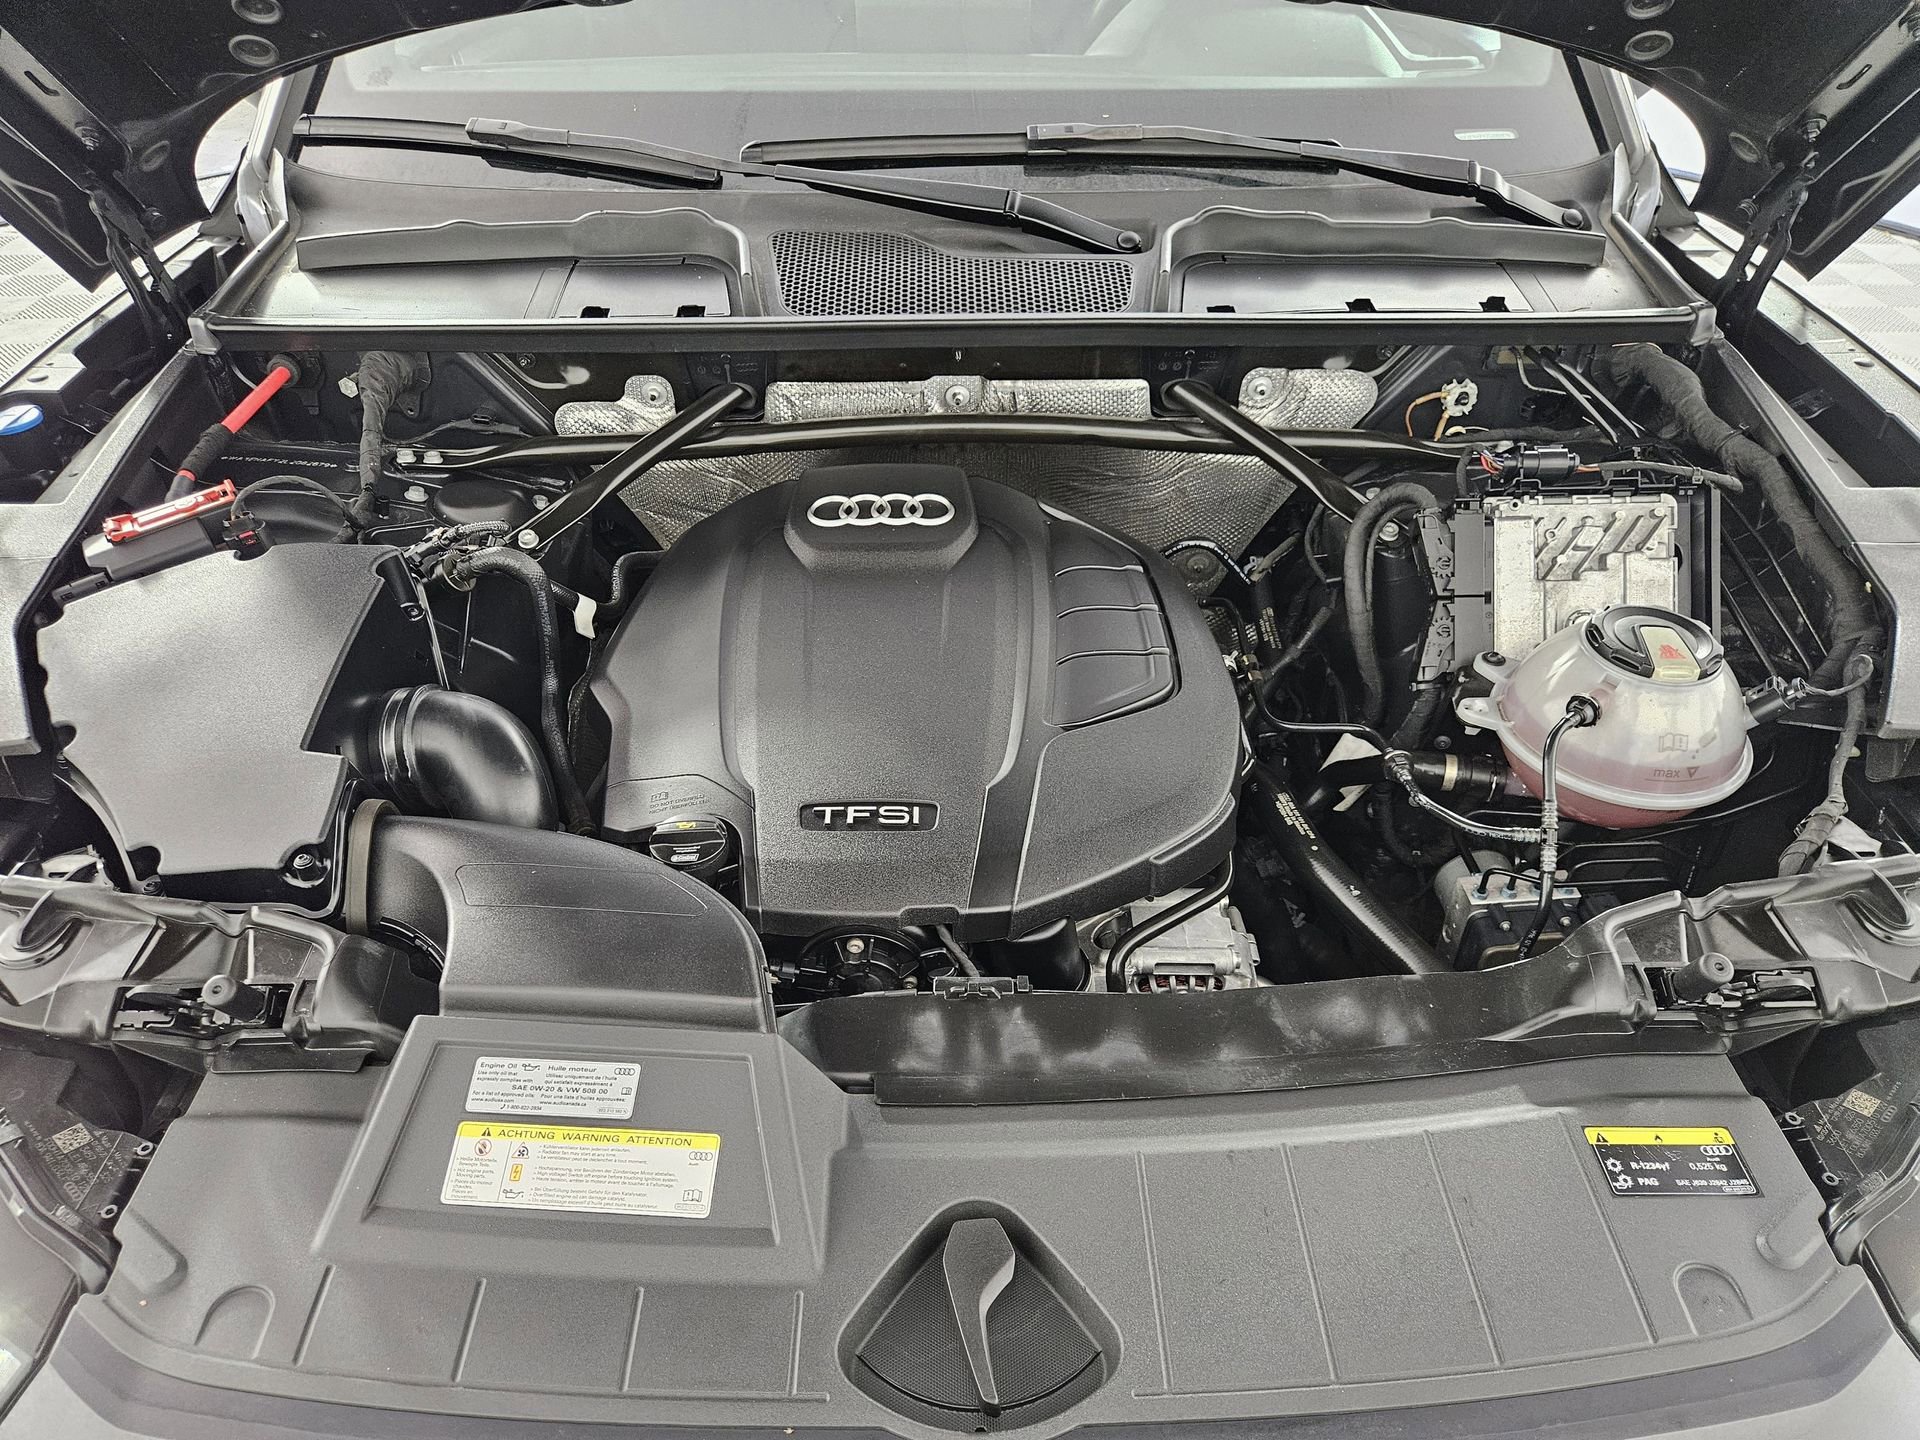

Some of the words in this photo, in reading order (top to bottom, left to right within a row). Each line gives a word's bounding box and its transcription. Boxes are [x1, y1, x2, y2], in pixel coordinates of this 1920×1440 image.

[1654, 768, 1680, 778] max
[812, 806, 920, 827] TFSI
[498, 1129, 555, 1140] ACHTUNG
[562, 1133, 619, 1143] WARNING
[627, 1136, 692, 1146] ATTENTION
[1630, 1162, 1670, 1171] R-1234yf
[1714, 1163, 1728, 1171] kg
